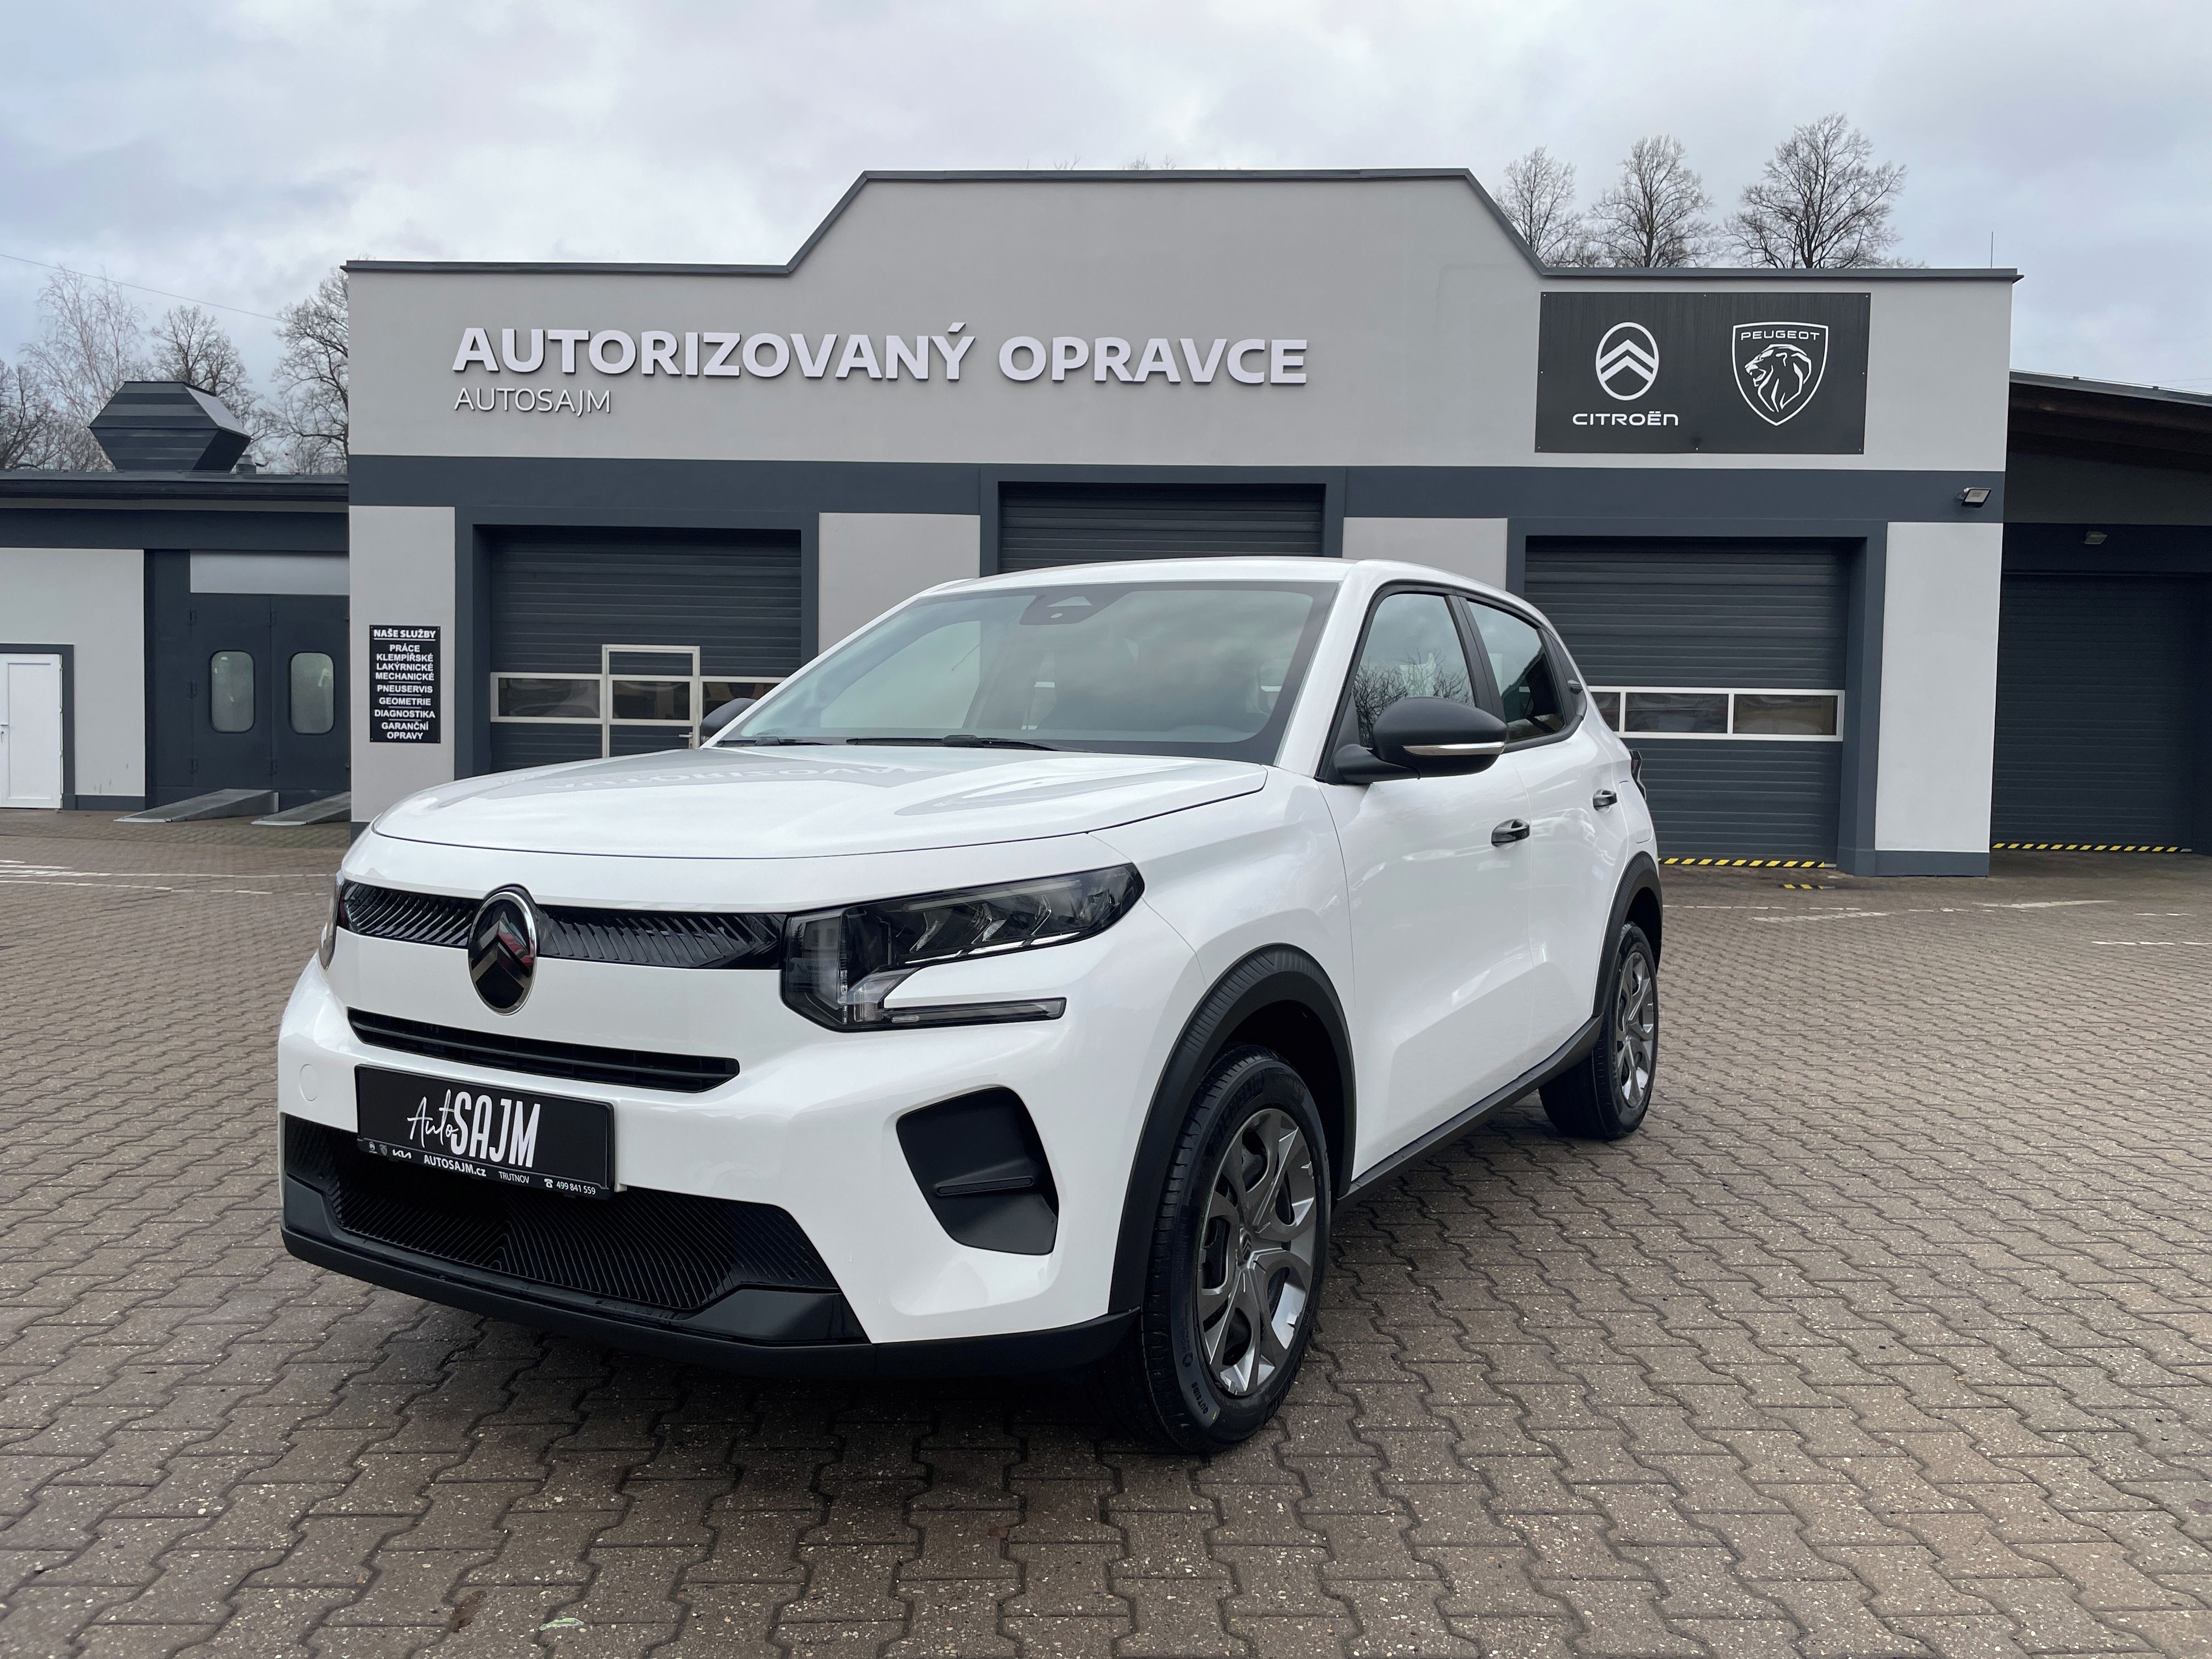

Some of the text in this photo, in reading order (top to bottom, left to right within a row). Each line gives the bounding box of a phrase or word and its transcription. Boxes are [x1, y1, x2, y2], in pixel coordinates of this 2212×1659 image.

[1740, 330, 1820, 341] PEUGEOT
[452, 321, 1308, 384] AUTORIZOVANÝ OPRAVCE
[454, 387, 611, 417] AUTOSAJM
[374, 628, 436, 639] NAŠE SLUŽBY
[390, 643, 420, 652] PRÁCE
[376, 653, 433, 662] KLEMPÍŘSKÉ
[376, 662, 433, 672] LAKÝRNICKÉ
[375, 672, 435, 681] MECHANICKÉ
[377, 685, 433, 693] PNEUSERVIS
[379, 697, 431, 706] GEOMETRIE
[374, 709, 436, 718] DIAGNOSTIKA
[381, 721, 429, 730] GARANČNÍ
[387, 731, 423, 740] OPRAVY
[424, 1154, 487, 1177] AUTOSAJM.cz
[498, 1171, 529, 1184] TRUTNOV
[556, 1181, 568, 1190] 499
[570, 1183, 582, 1192] 841
[583, 1186, 596, 1195] 559
